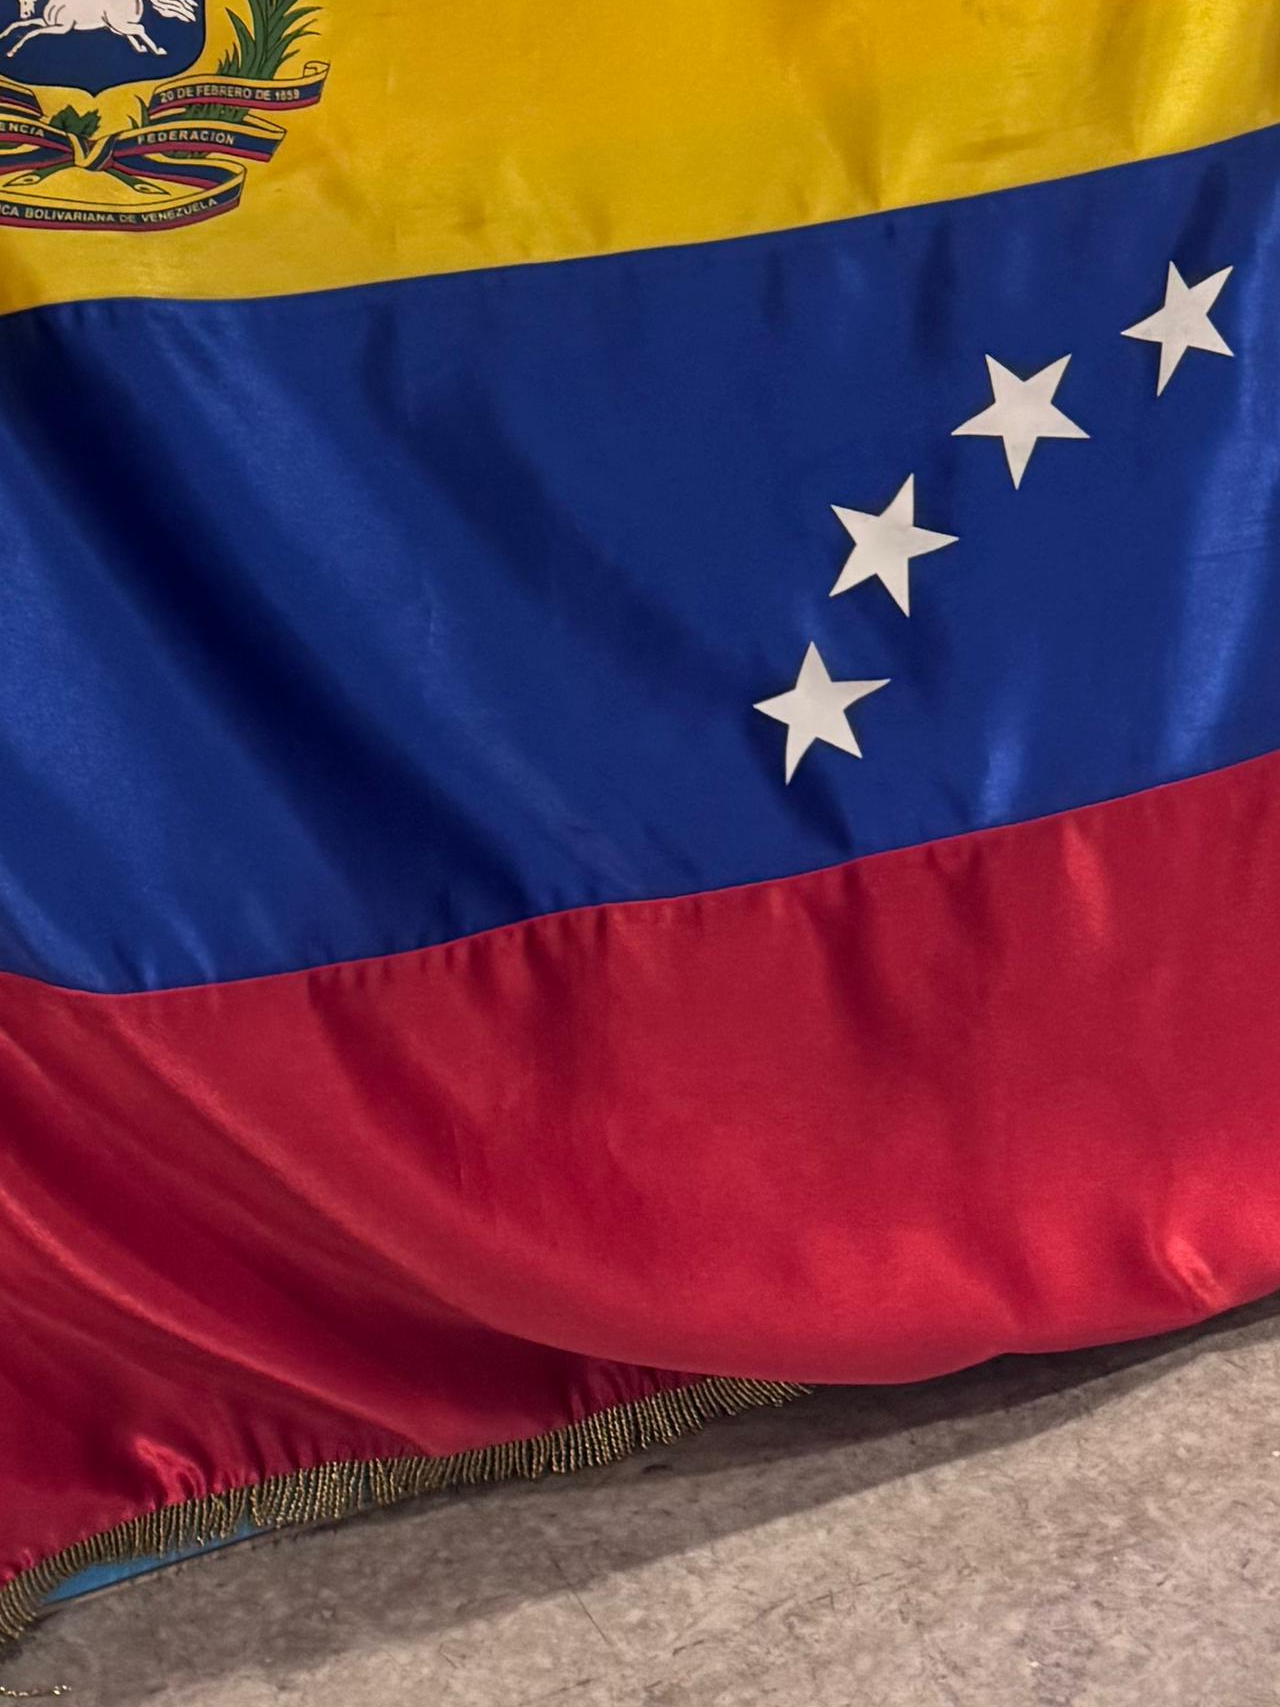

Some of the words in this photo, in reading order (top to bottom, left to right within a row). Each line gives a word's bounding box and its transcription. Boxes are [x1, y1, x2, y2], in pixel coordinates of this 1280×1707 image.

[160, 90, 175, 103] 20
[177, 87, 194, 99] DE
[196, 85, 253, 100] FEBRERO
[255, 89, 271, 101] DE
[138, 129, 235, 145] FEDERACION
[25, 207, 114, 223] BOLIVARIANA
[120, 213, 136, 223] DE
[141, 197, 218, 224] VENEZUELA
